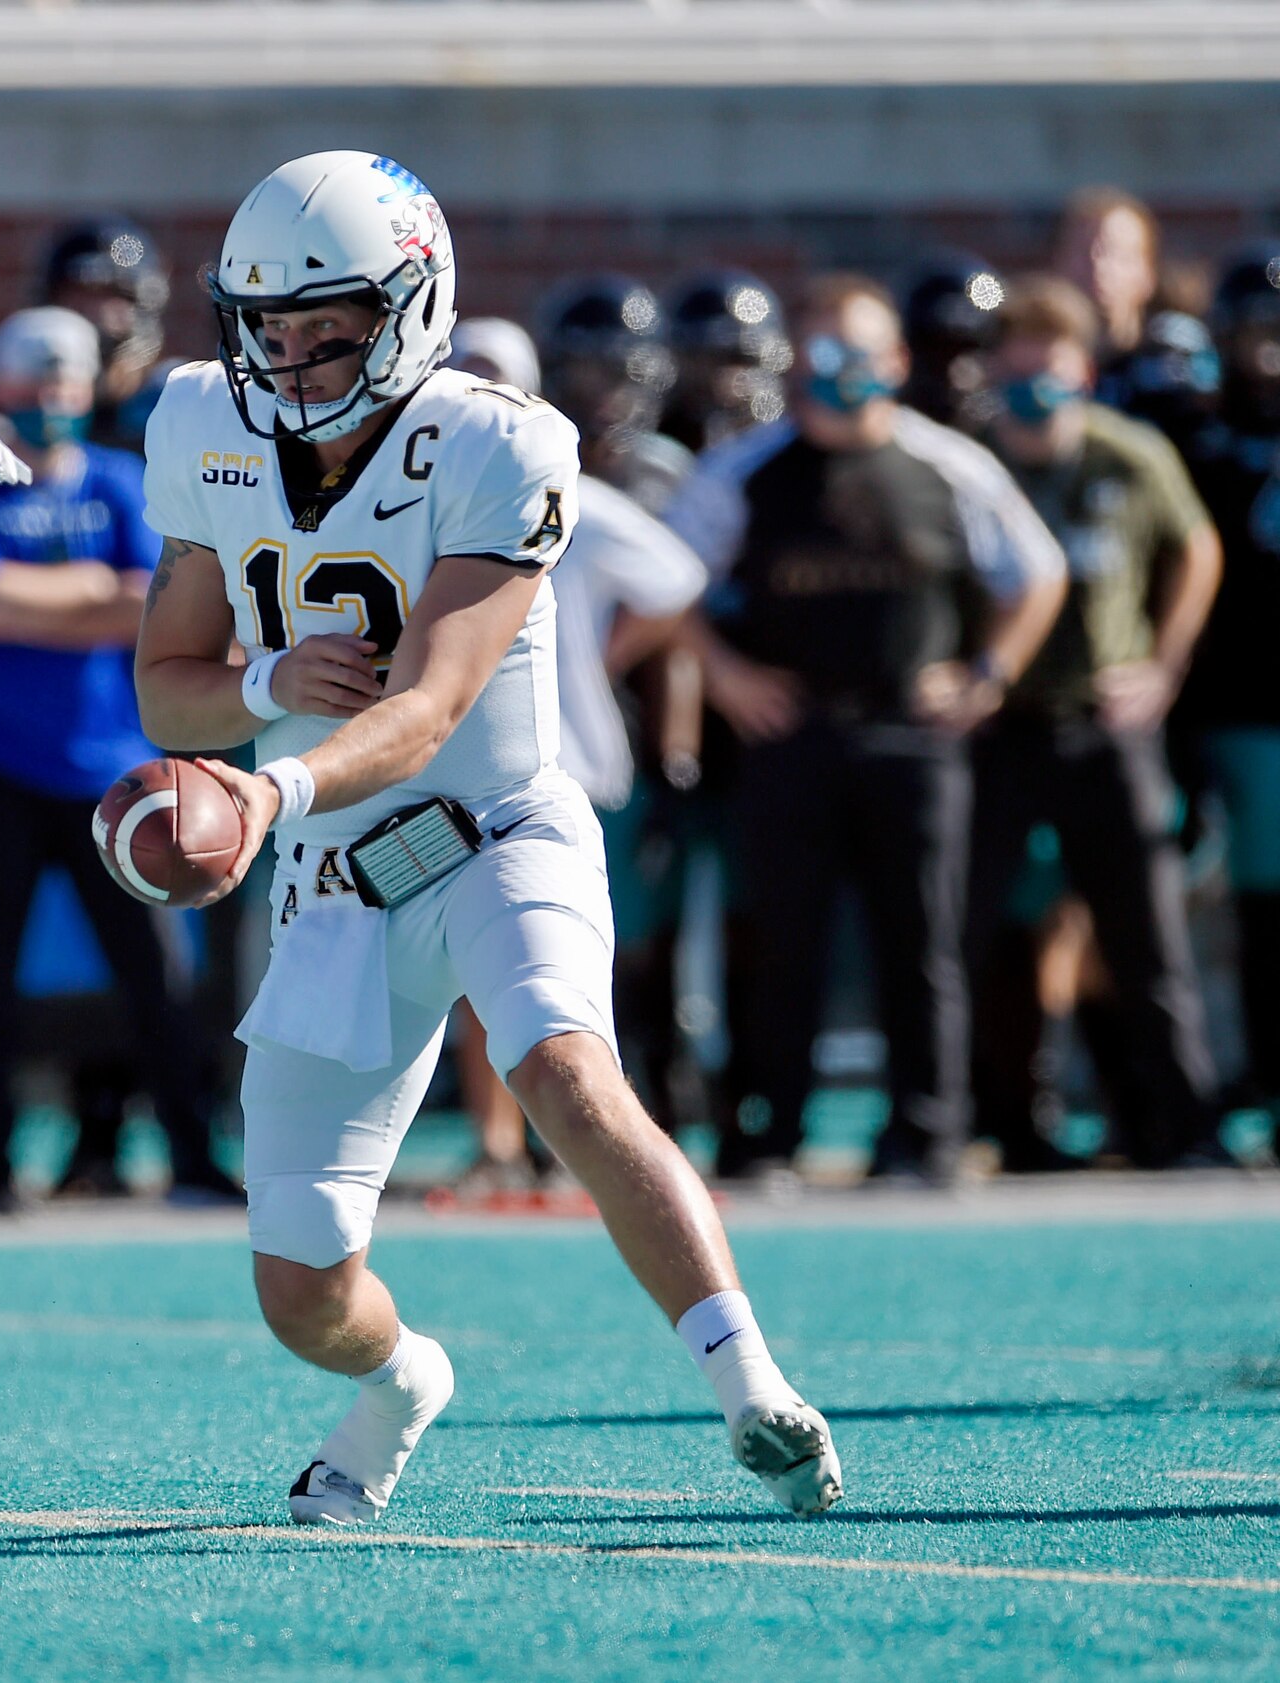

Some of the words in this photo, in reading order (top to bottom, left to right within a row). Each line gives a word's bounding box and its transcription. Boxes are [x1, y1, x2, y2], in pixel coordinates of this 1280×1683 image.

[245, 263, 263, 285] A
[202, 451, 263, 487] SBC
[402, 423, 440, 481] C
[295, 505, 318, 530] A
[523, 485, 566, 551] A
[314, 847, 358, 897] A
